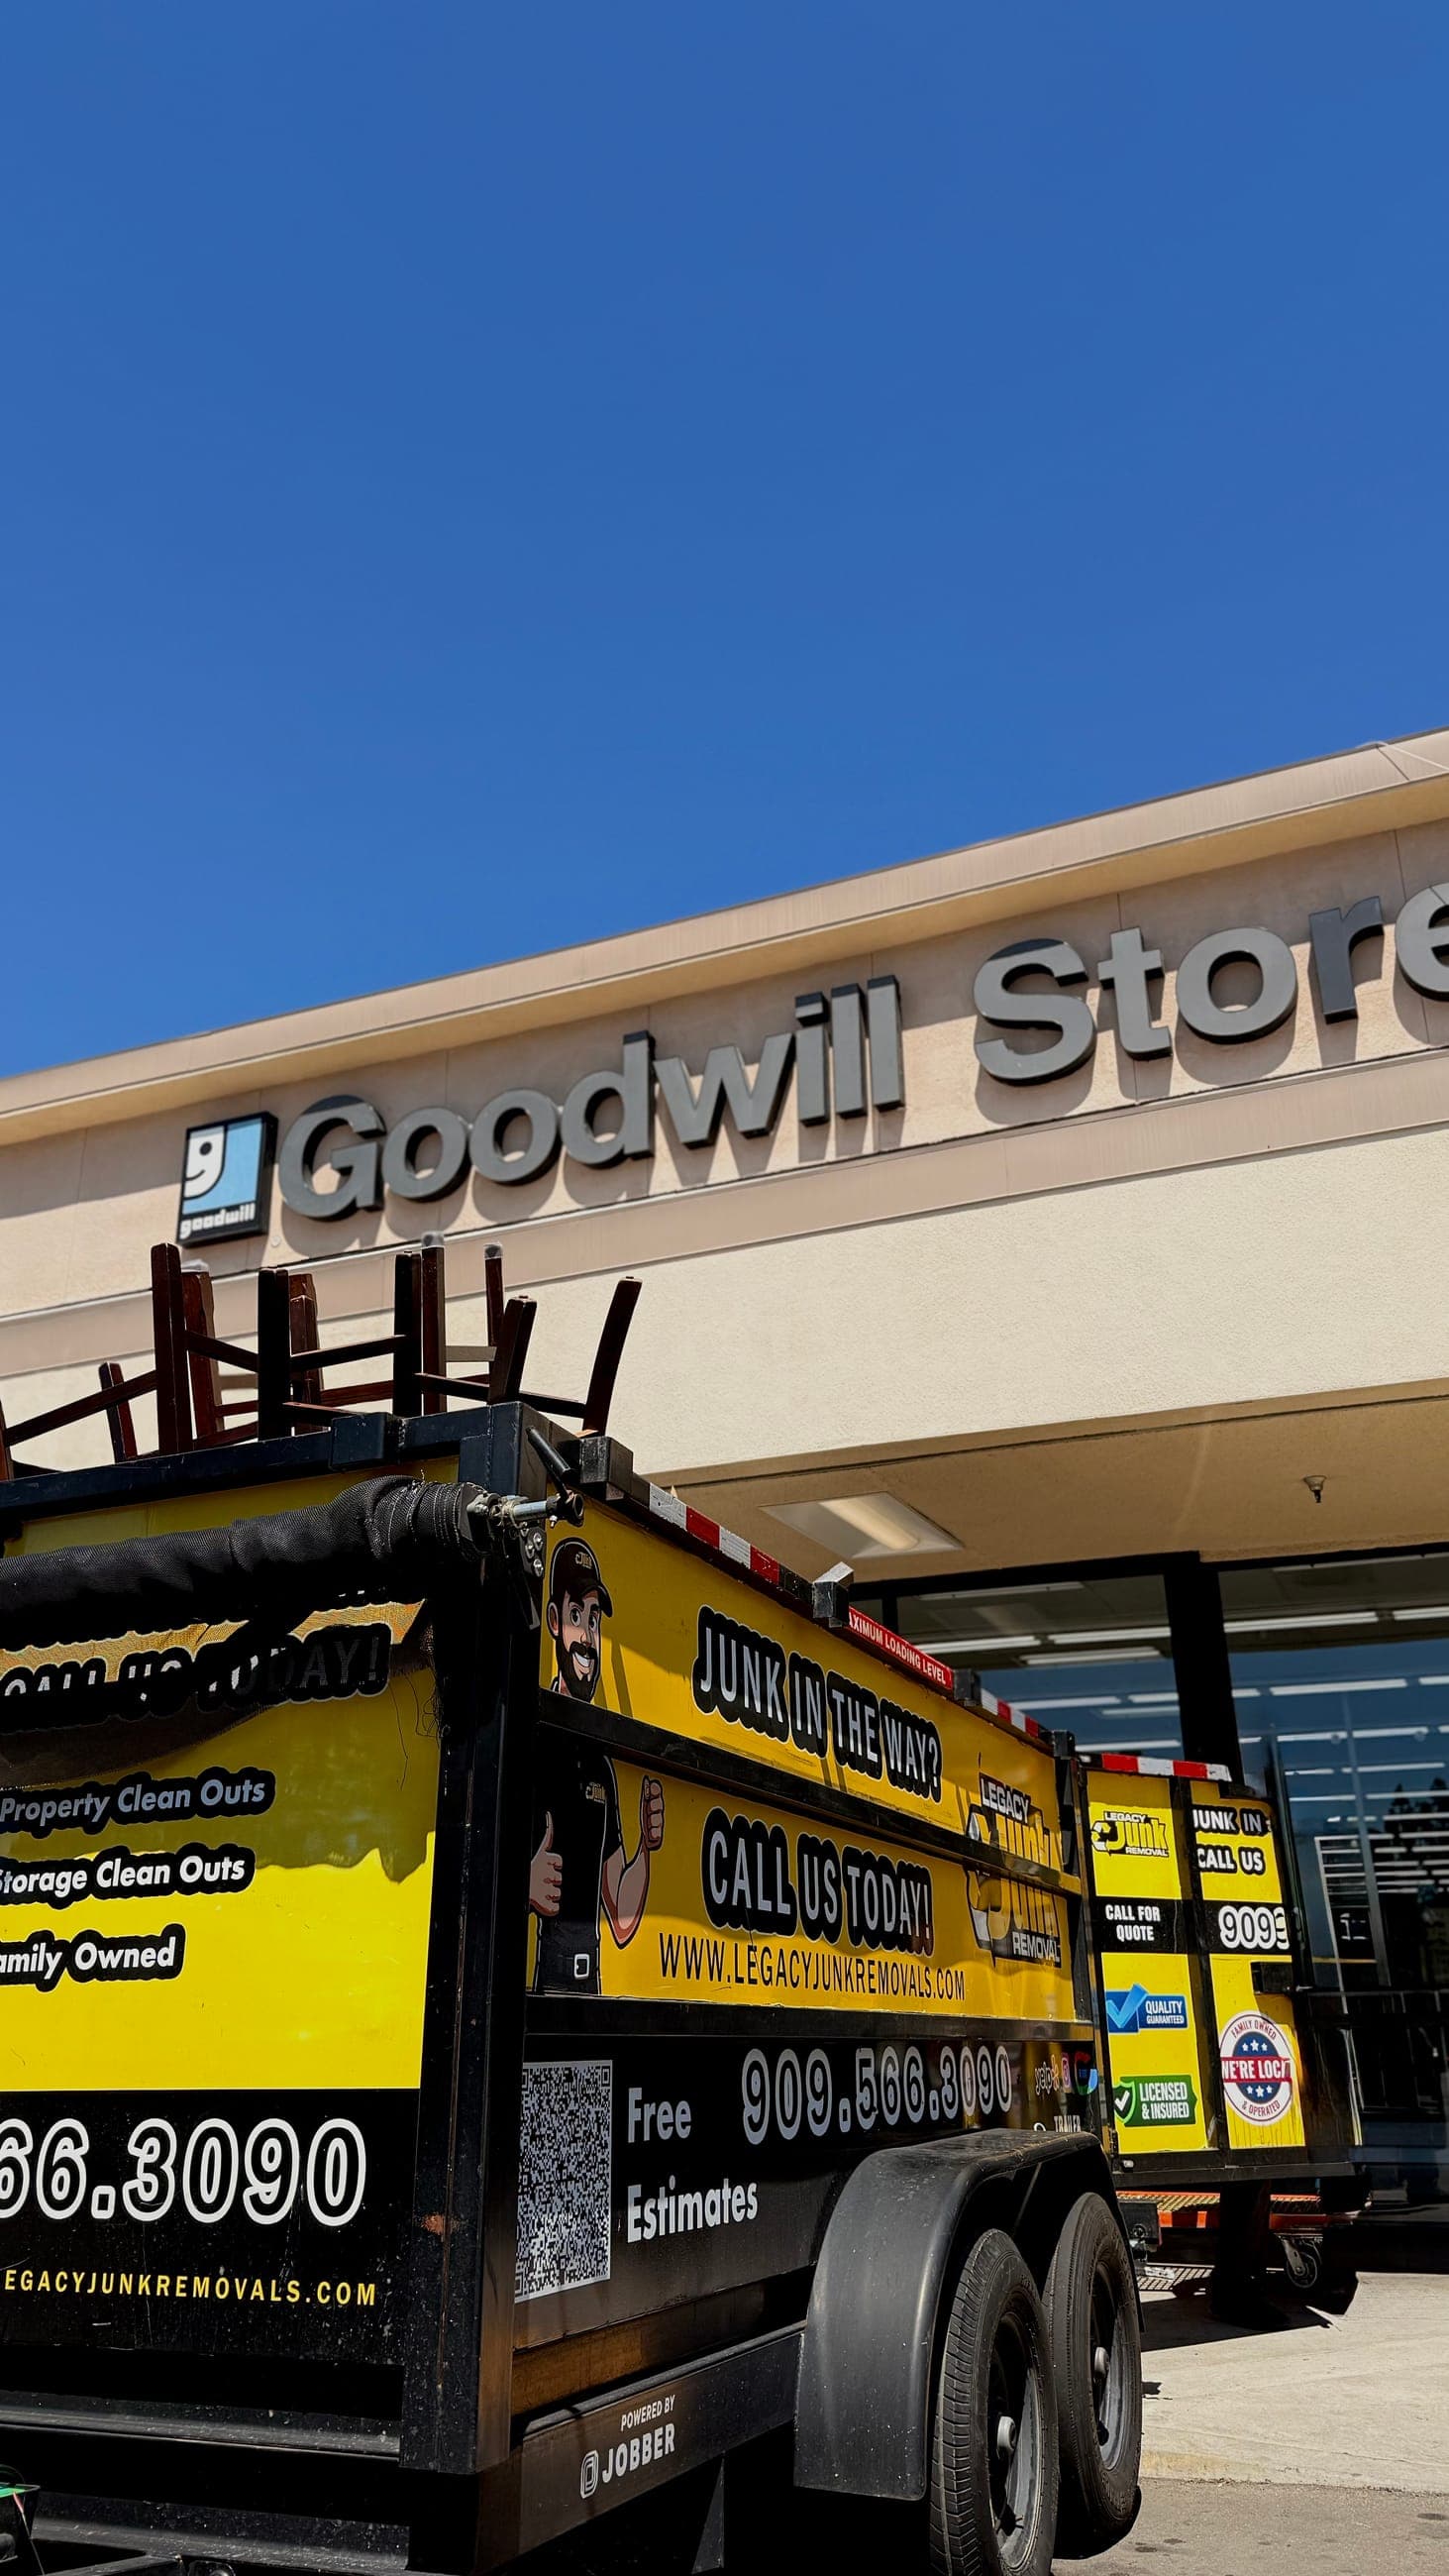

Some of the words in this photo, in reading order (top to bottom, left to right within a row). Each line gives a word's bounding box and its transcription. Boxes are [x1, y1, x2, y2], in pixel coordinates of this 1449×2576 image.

[278, 975, 905, 1222] Goodwill
[179, 1203, 256, 1239] goodwill
[884, 1634, 921, 1669] LOADING
[922, 1659, 946, 1684] LEVEL
[700, 1627, 783, 1723] JUNK
[794, 1669, 823, 1739] IN
[830, 1690, 878, 1762] THE
[884, 1708, 941, 1788] WAY?
[0, 1793, 110, 1826] Property
[118, 1783, 190, 1813] Clean
[201, 1779, 264, 1806] Outs
[981, 1778, 1029, 1824] LEGACY
[1104, 1812, 1147, 1823] LEGACY
[1243, 1812, 1263, 1832] IN
[1125, 1847, 1168, 1857] REMOVAL
[1196, 1848, 1235, 1869] CALL
[1241, 1850, 1264, 1872] US
[0, 1869, 87, 1897] torage
[97, 1856, 169, 1888] Clean
[179, 1855, 245, 1883] Outs
[709, 1830, 791, 1914] CALL
[804, 1855, 836, 1923] US
[848, 1865, 932, 1939] TODAY!
[1105, 1904, 1135, 1921] CALL
[1138, 1905, 1161, 1922] FOR
[1012, 1932, 1061, 1963] REMOVAL
[1116, 1924, 1155, 1941] QUOTE
[75, 1937, 176, 1971] Owned
[660, 1931, 966, 2000] WWW.LEGACYJUNKREMOVALS.COM
[1145, 2000, 1183, 2015] QUALITY
[1146, 2015, 1185, 2025] GUARANTEED
[1231, 2019, 1253, 2039] FAMILY
[1254, 2019, 1277, 2041] OWNED
[741, 2046, 1012, 2145] 909.566.3090
[1139, 2082, 1189, 2101] LICENSED
[1248, 2099, 1281, 2118] OPERATED
[627, 2087, 692, 2144] Free
[1141, 2102, 1149, 2120] &
[1150, 2101, 1190, 2119] INSURED
[627, 2176, 758, 2243] Estimates
[4, 2269, 377, 2306] EGACYJUNKREMOVALS.COM
[621, 2400, 663, 2432] POWERED
[665, 2394, 675, 2414] BY
[601, 2422, 675, 2484] JOBBER
